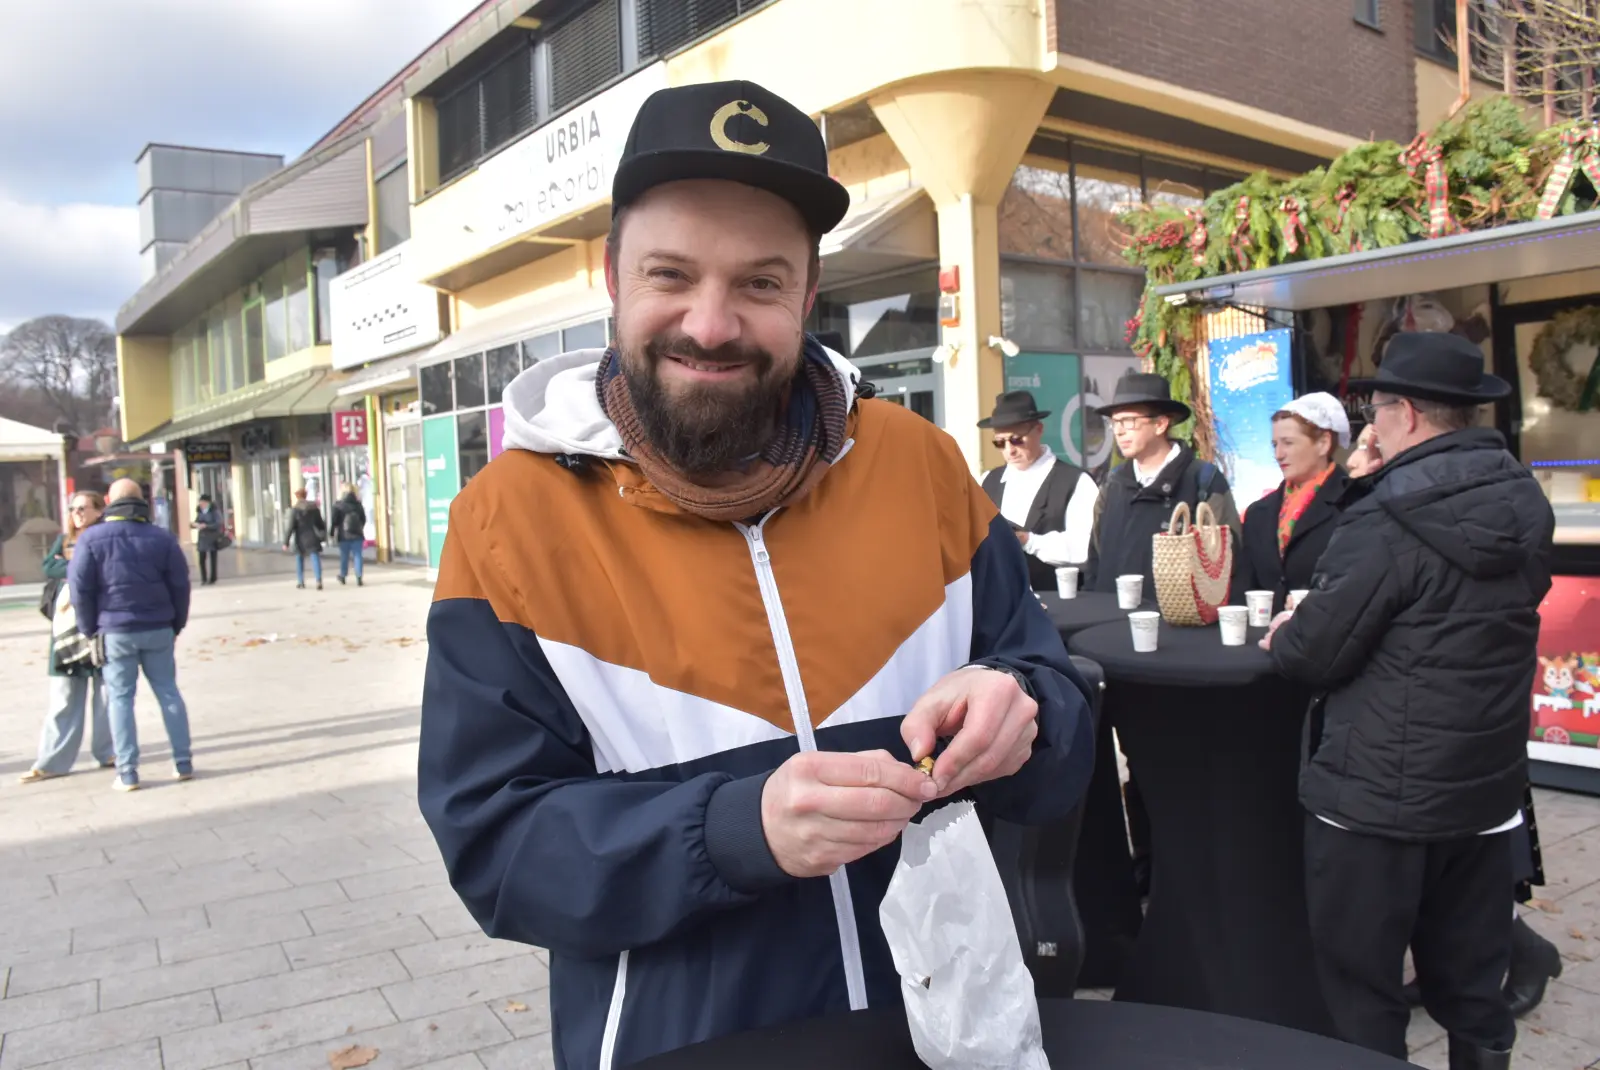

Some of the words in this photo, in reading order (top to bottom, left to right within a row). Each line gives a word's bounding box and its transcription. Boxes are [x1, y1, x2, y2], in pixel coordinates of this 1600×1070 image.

[545, 109, 601, 164] URBIA
[563, 153, 606, 203] orbi
[341, 416, 363, 441] T
